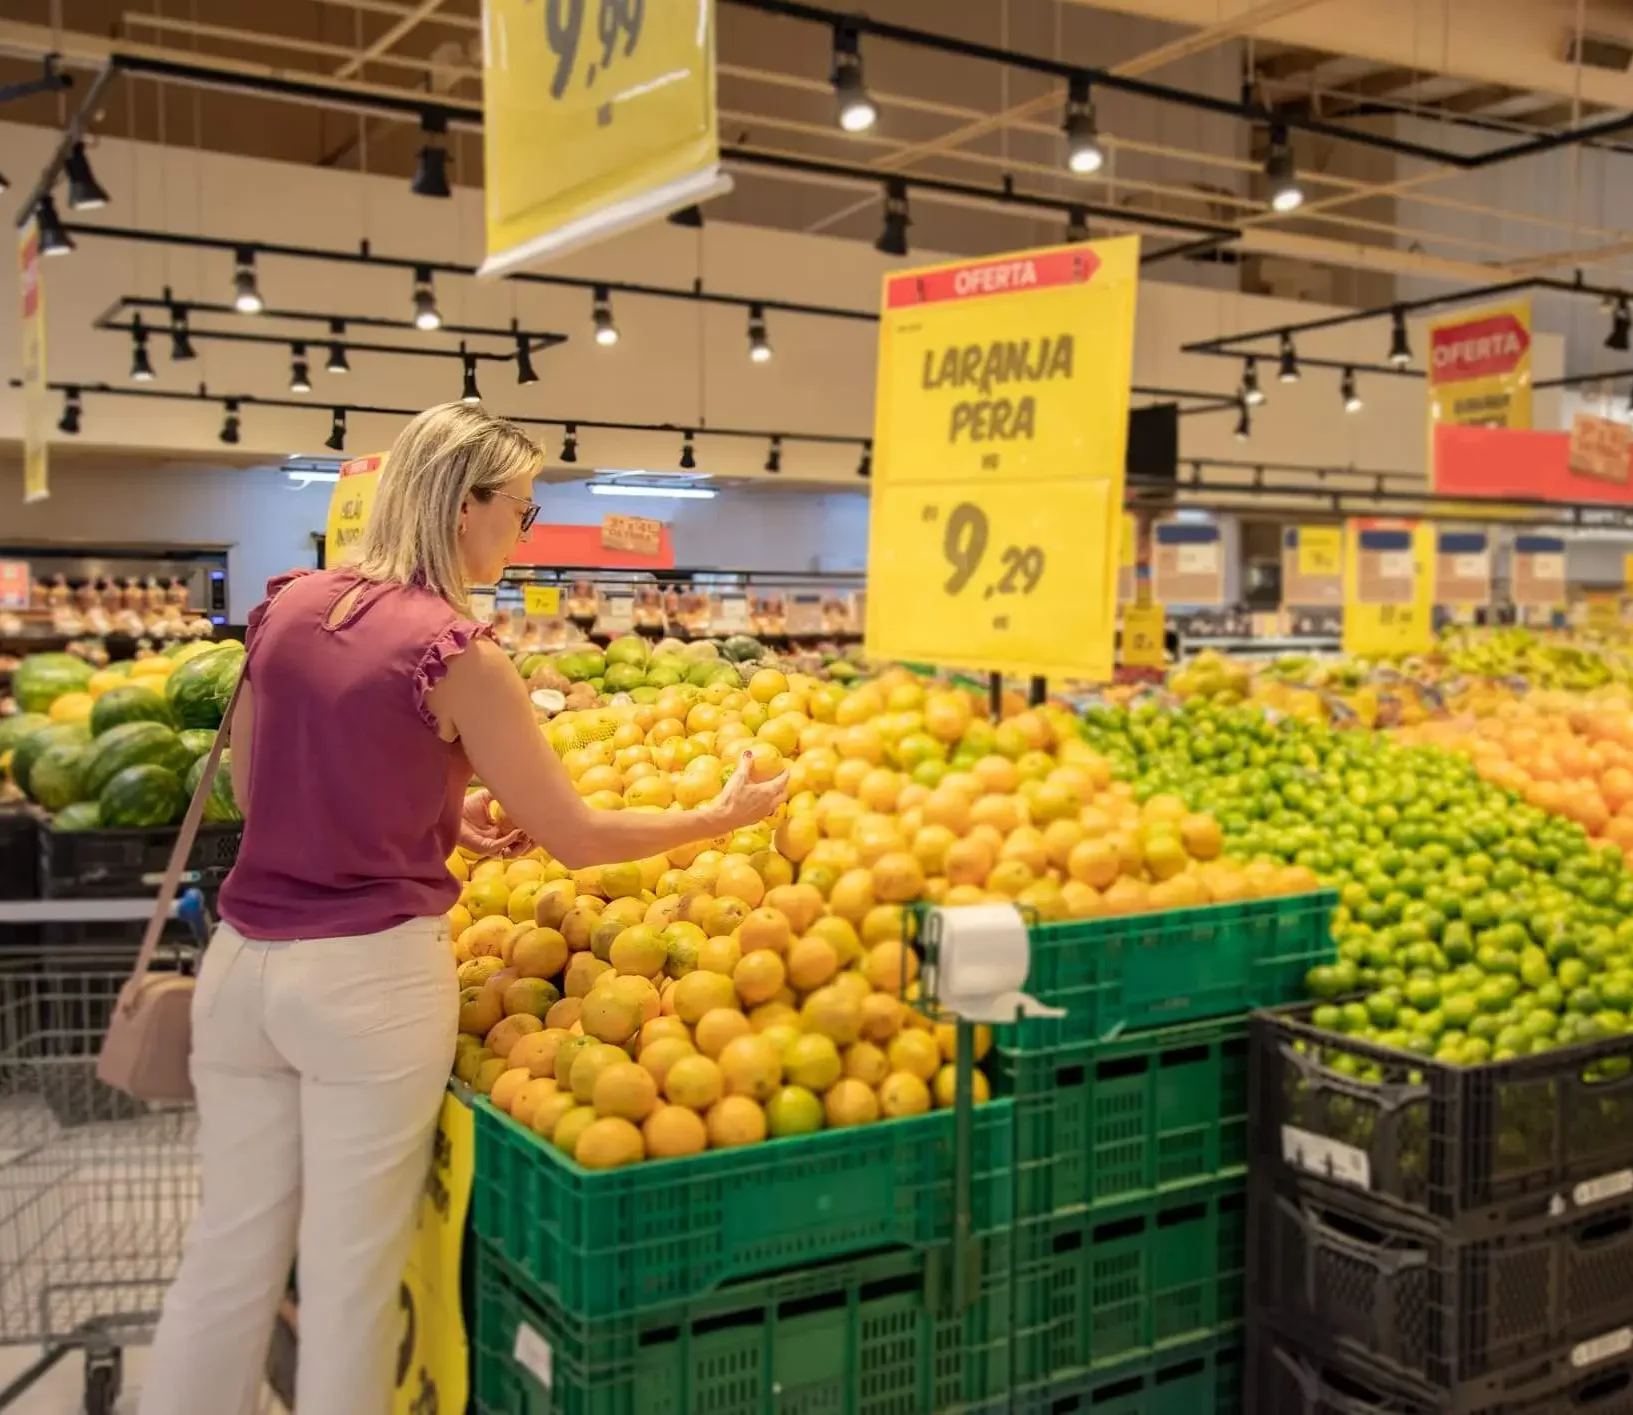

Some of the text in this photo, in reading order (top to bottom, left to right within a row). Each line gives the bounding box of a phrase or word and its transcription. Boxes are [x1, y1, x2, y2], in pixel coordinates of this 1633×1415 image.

[954, 260, 1037, 296] OFERTA
[922, 333, 1074, 391] LARANJA
[1434, 330, 1521, 368] OFERTA
